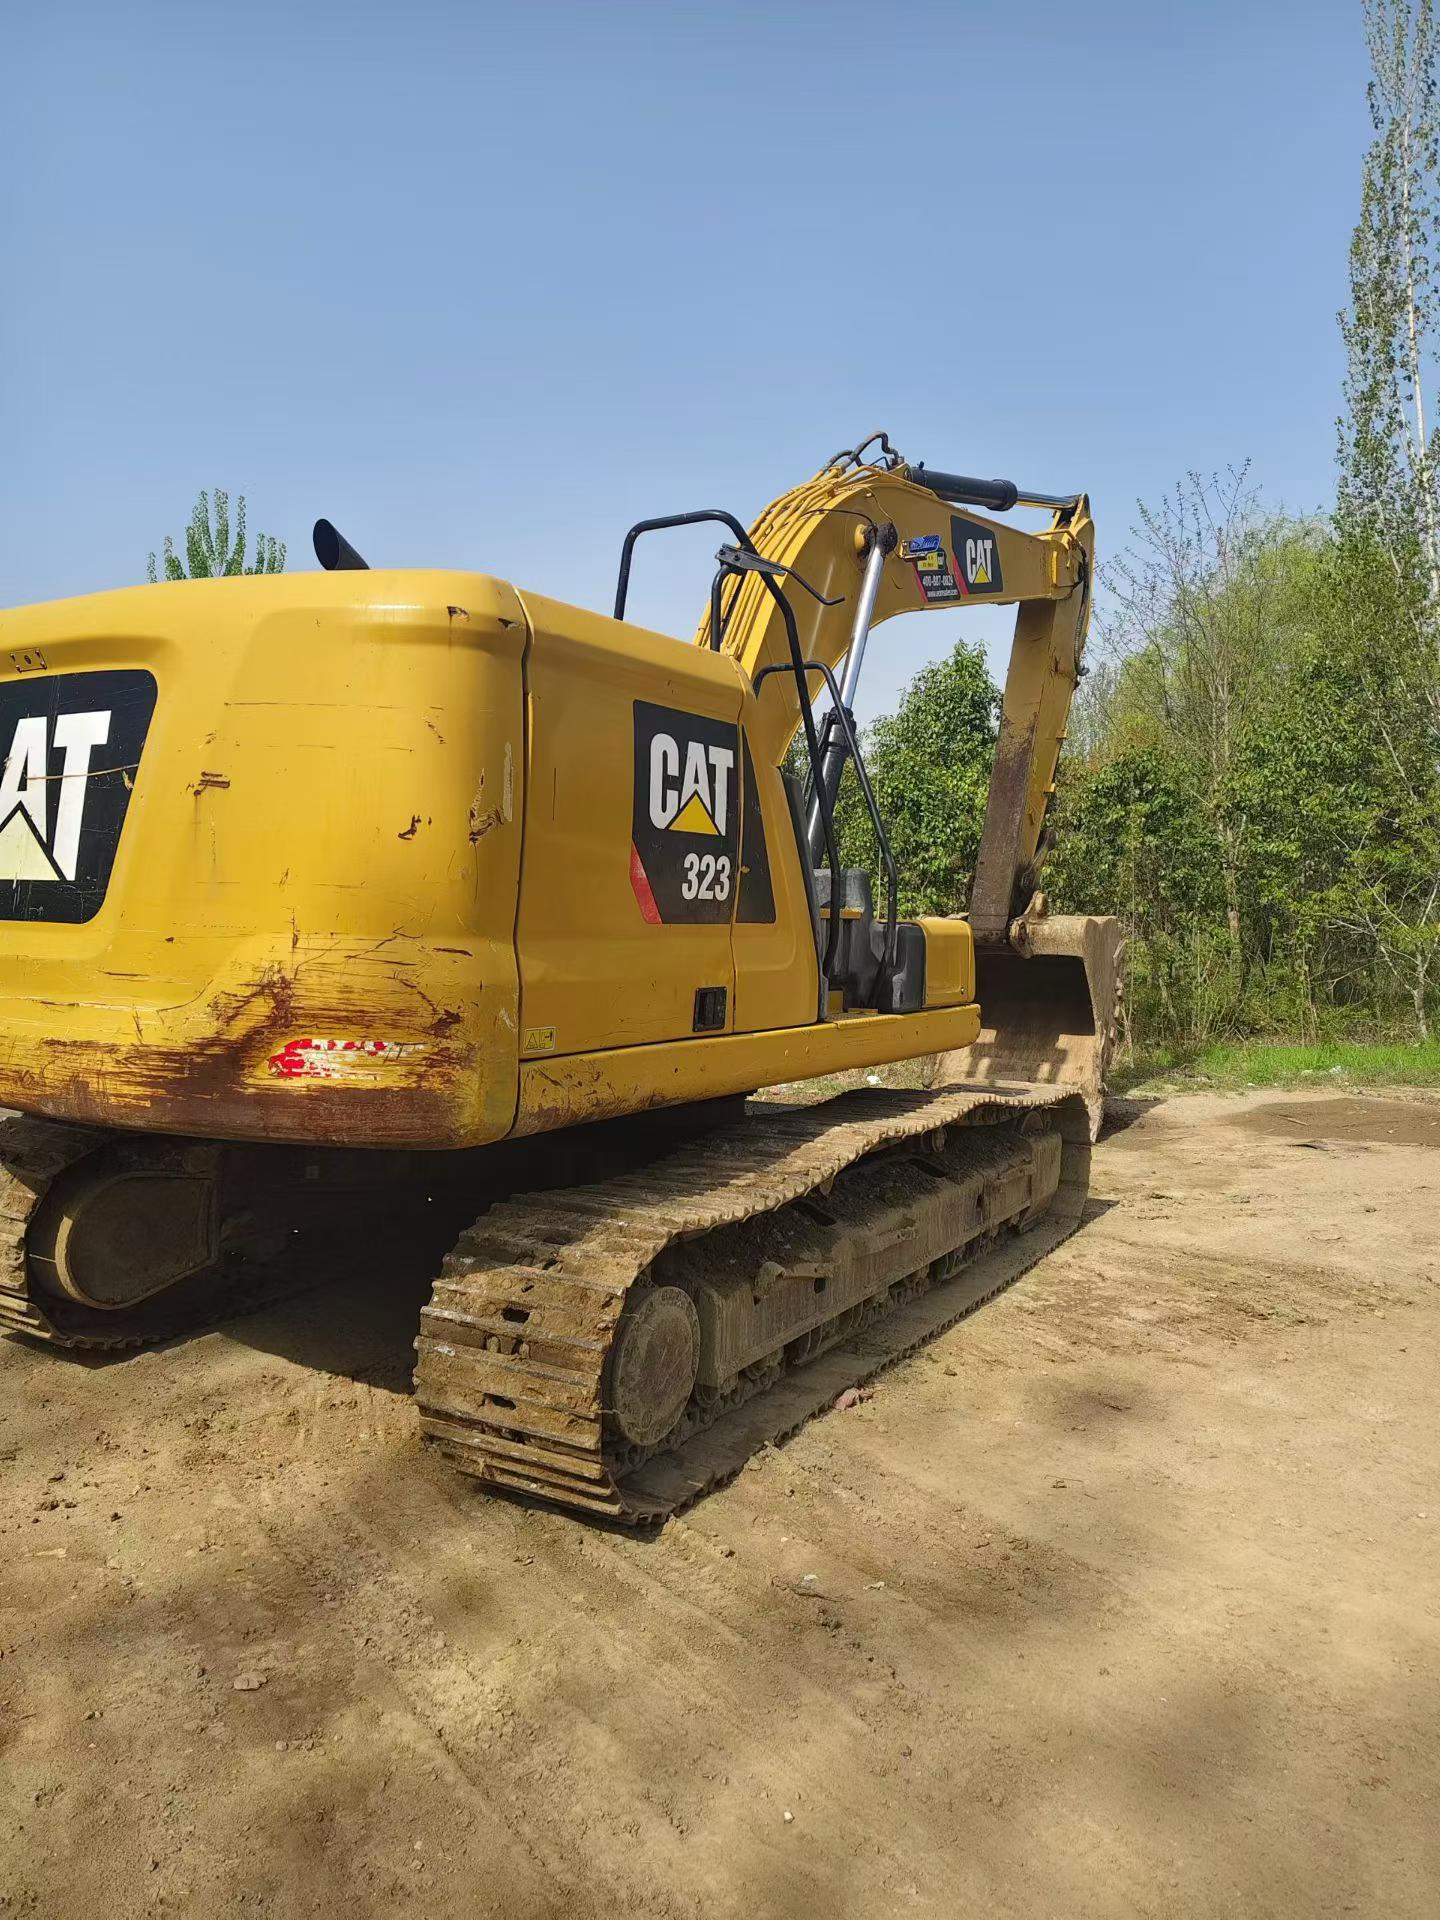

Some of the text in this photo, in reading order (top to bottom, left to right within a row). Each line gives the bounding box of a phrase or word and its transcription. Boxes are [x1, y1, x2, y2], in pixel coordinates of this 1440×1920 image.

[966, 539, 993, 584] CAT
[649, 733, 734, 836] CAT
[681, 852, 731, 901] 323
